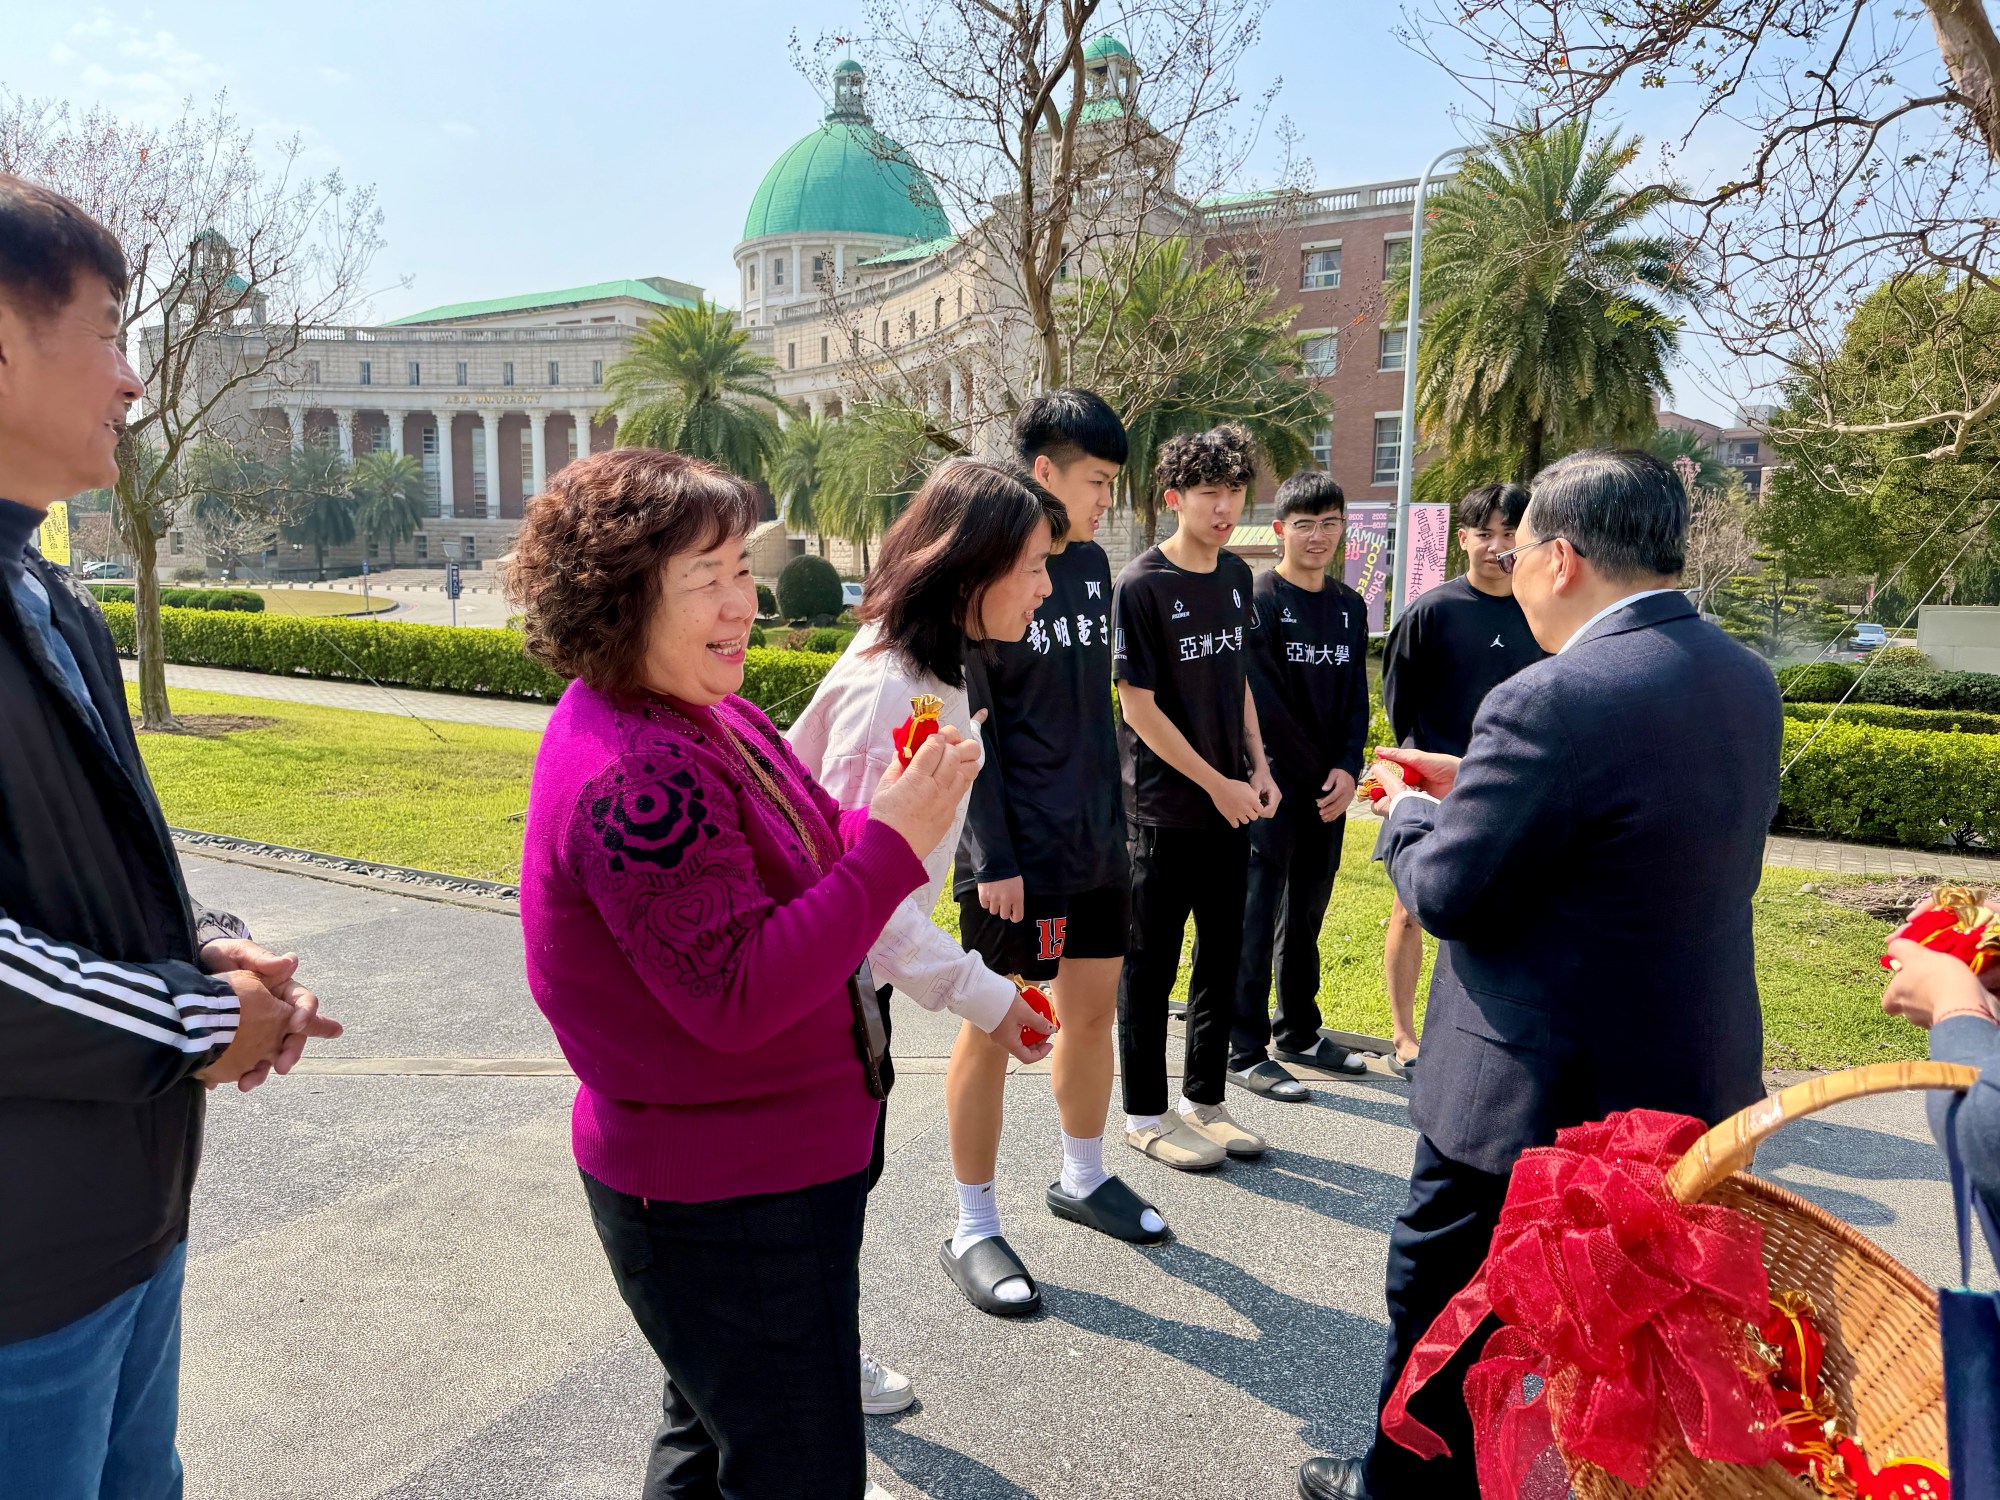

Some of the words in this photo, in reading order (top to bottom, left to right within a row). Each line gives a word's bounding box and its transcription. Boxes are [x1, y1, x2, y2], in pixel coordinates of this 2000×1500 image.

[445, 394, 471, 404] ASIA
[475, 393, 542, 405] UNIVERSITY
[1179, 626, 1243, 661] 亞洲大學
[1285, 641, 1350, 666] 亞洲大學
[1036, 916, 1067, 960] 15
